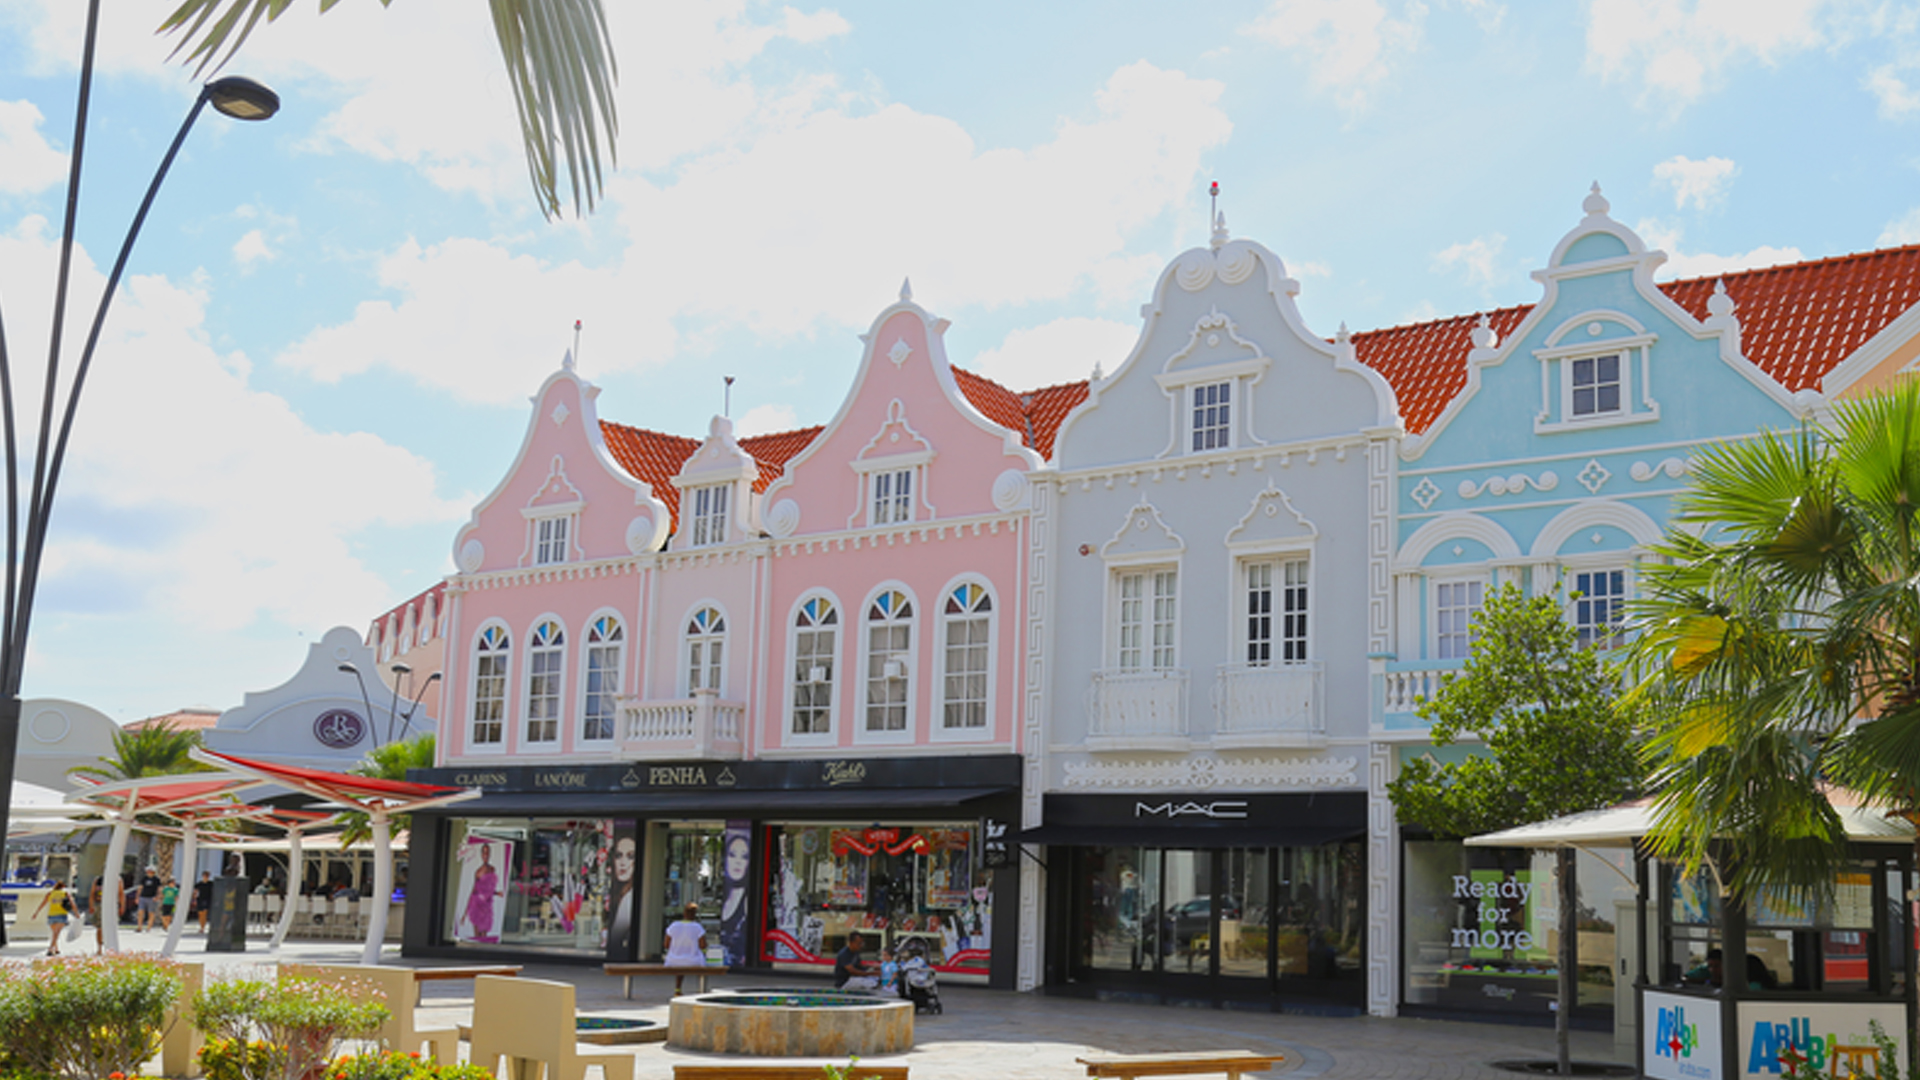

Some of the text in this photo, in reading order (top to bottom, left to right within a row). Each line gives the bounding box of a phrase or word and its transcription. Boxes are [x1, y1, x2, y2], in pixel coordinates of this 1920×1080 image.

[455, 772, 507, 785] CLARINS
[649, 767, 707, 785] PENHA
[1136, 801, 1248, 818] MAC
[1452, 875, 1534, 905] Ready
[1477, 901, 1511, 923] for
[1451, 928, 1534, 951] more
[1655, 1005, 1699, 1058] ARUBA
[1747, 1016, 1839, 1074] ARUBA
